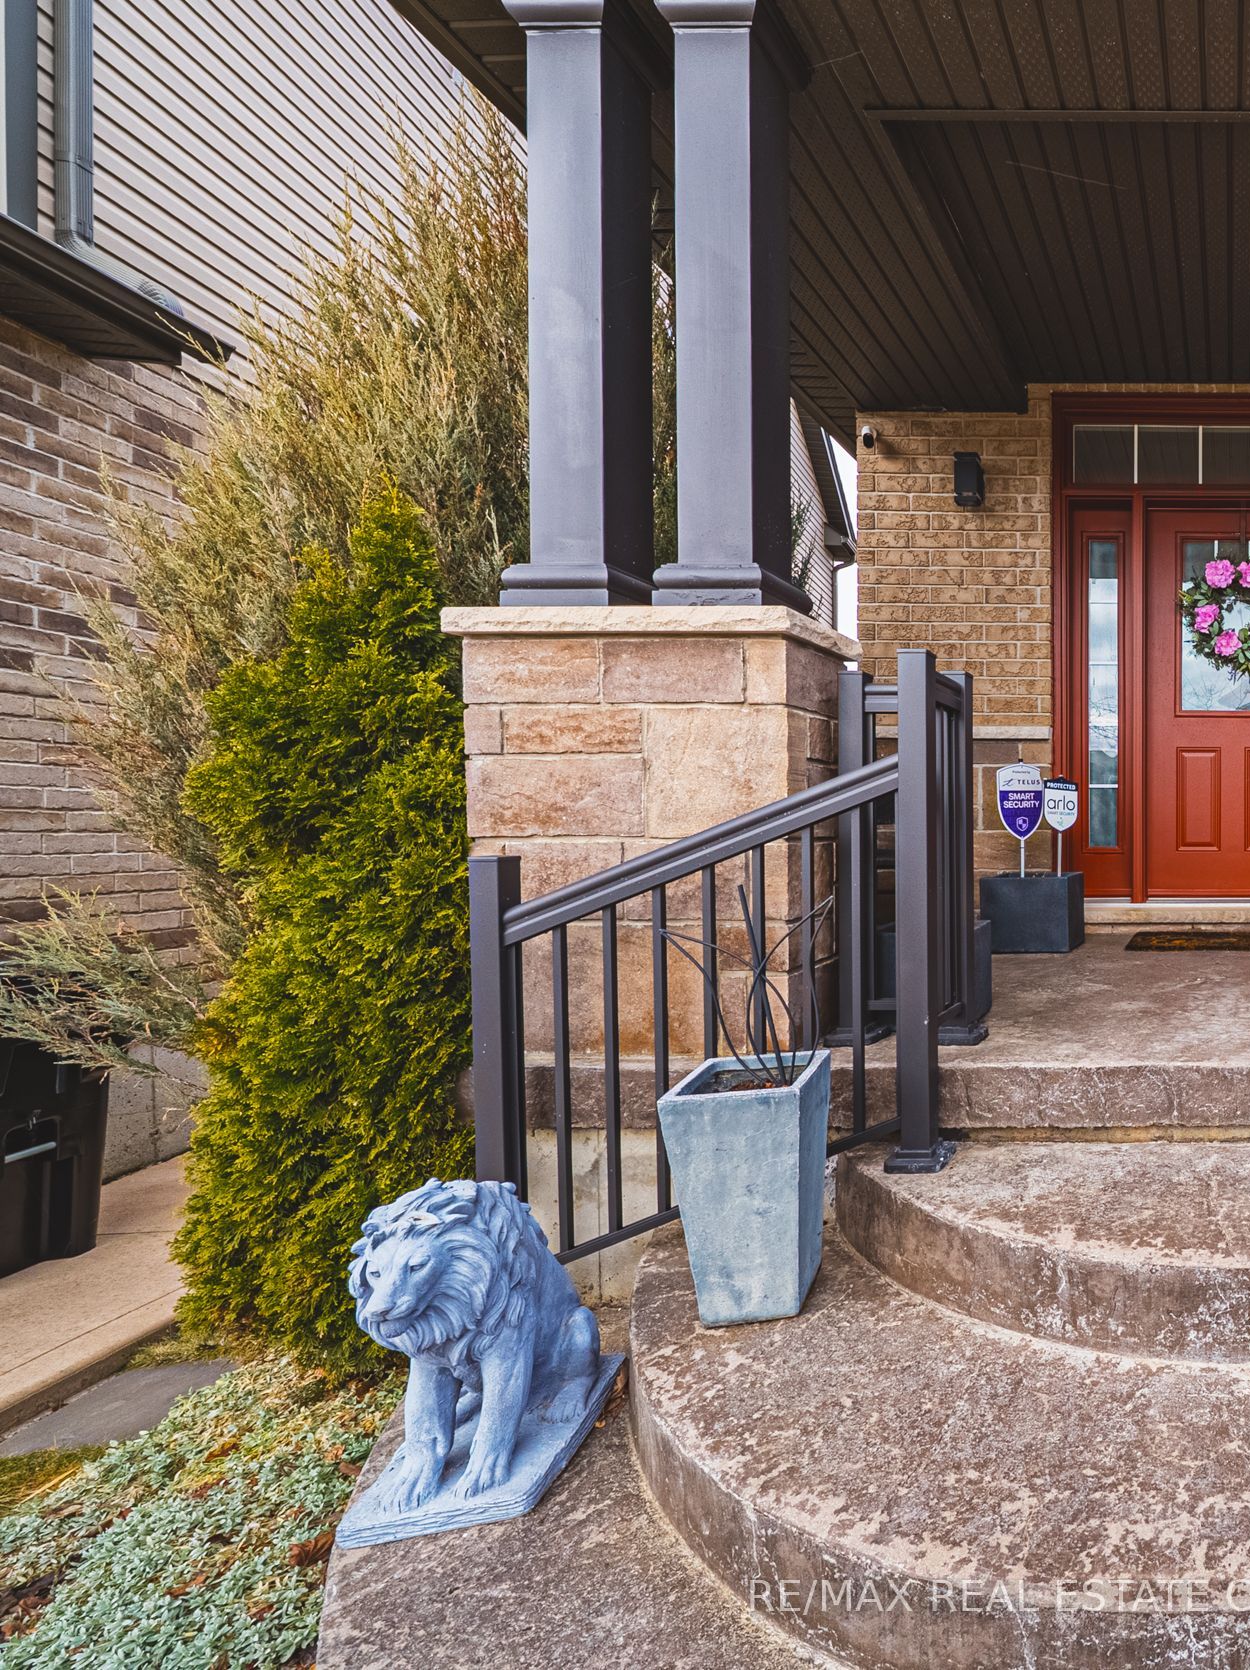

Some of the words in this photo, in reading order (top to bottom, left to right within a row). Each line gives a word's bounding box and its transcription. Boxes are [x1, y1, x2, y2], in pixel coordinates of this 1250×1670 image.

[1046, 782, 1076, 790] PROTECTED
[1008, 792, 1035, 800] SMART
[1003, 800, 1040, 809] SECURITY
[1046, 795, 1076, 811] arlo
